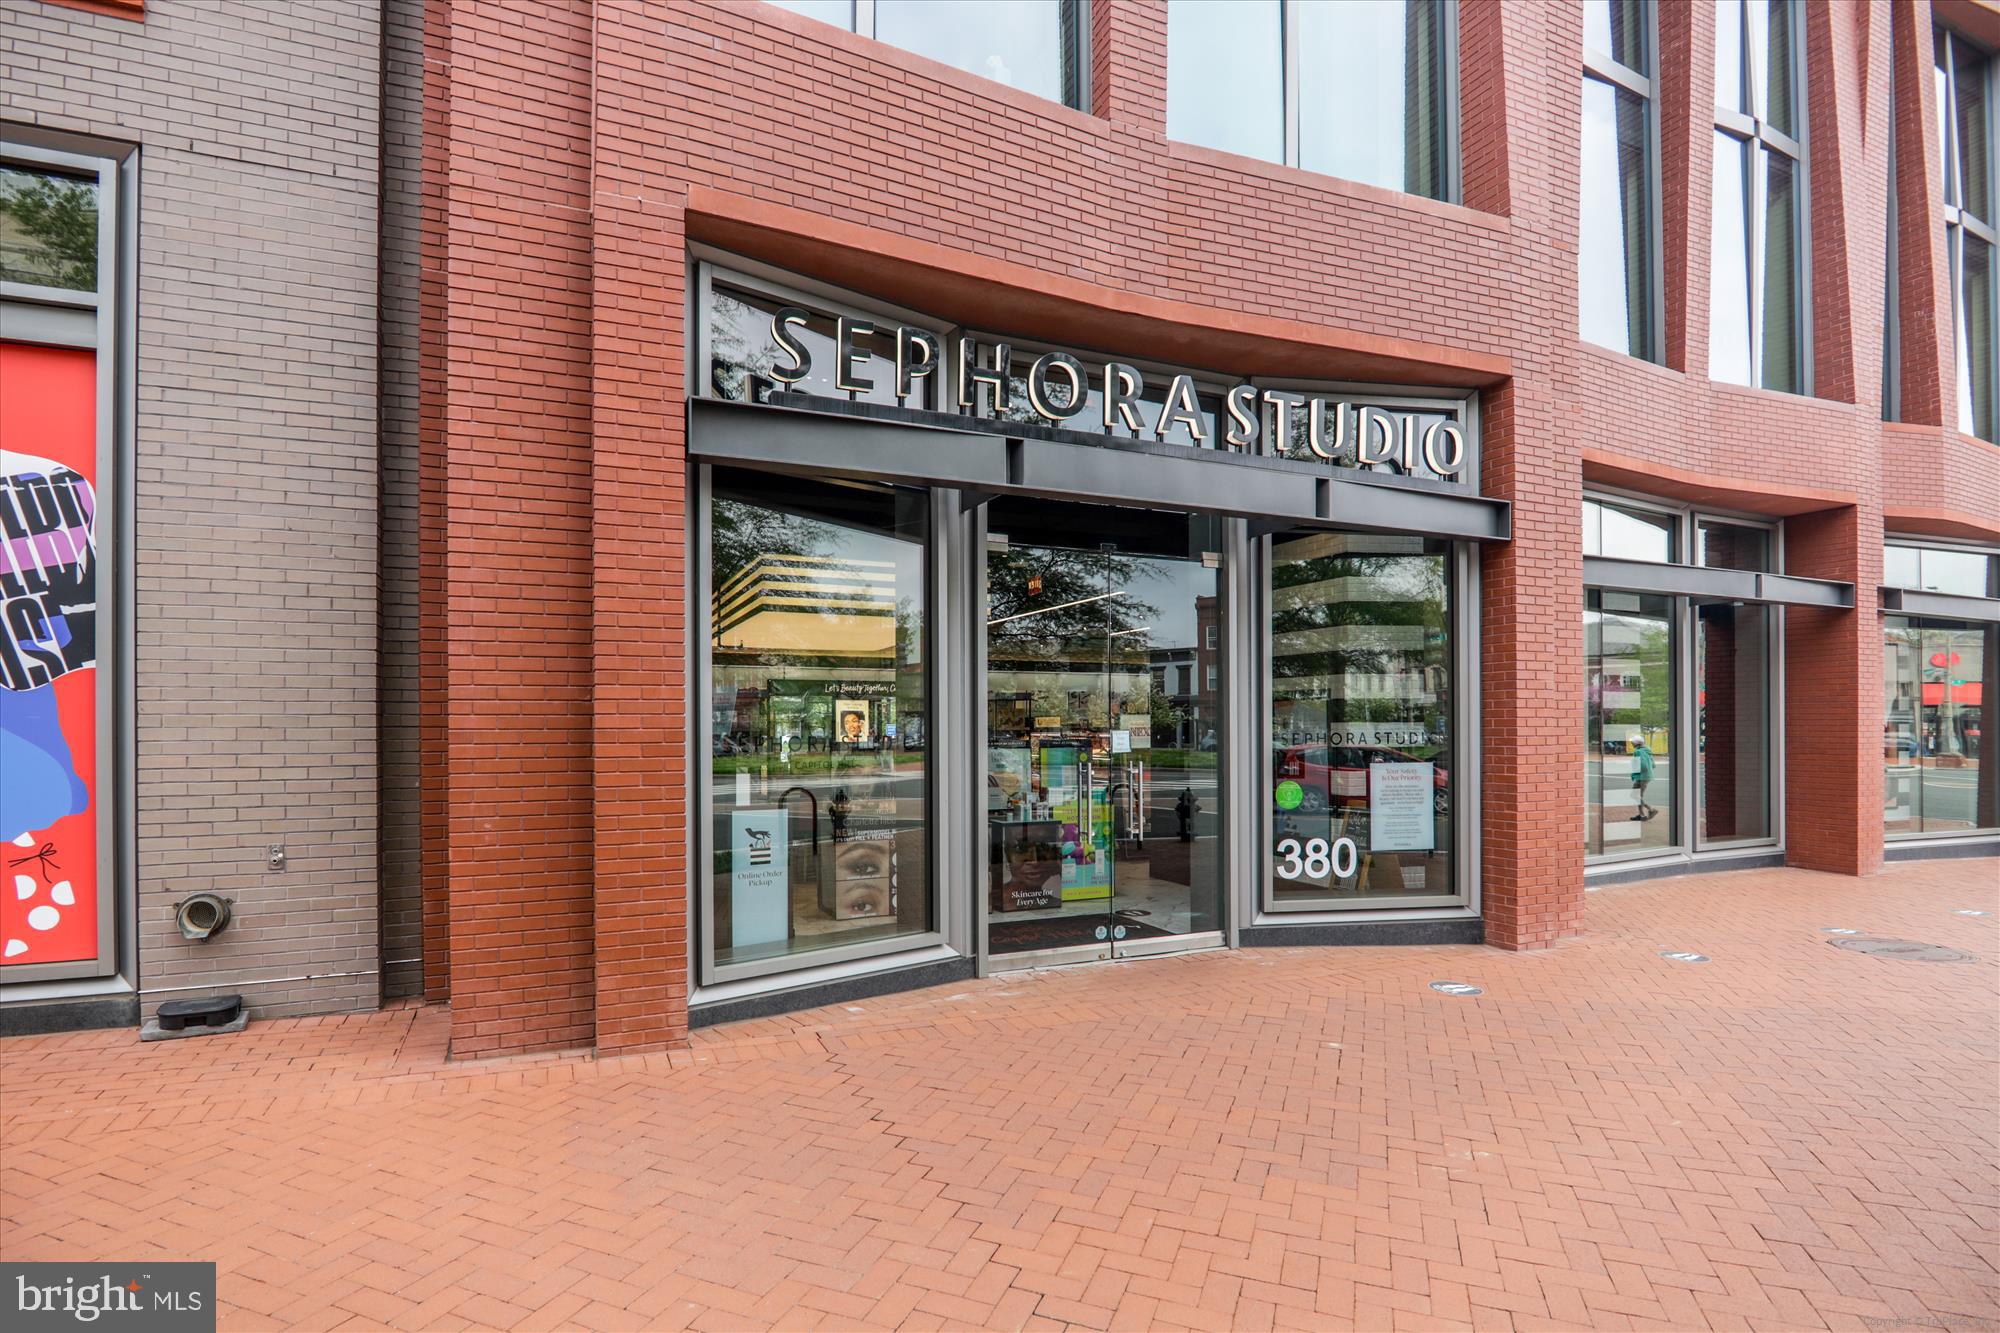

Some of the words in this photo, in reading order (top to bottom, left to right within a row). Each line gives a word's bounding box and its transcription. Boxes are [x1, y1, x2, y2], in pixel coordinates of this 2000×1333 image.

[768, 306, 1208, 440] SEPHORA
[1227, 384, 1469, 476] STUDIO
[1281, 731, 1368, 746] SEPHORA
[1277, 837, 1357, 880] 380
[737, 872, 761, 880] Online
[762, 870, 783, 878] Order
[748, 879, 773, 887] Pickup
[1011, 890, 1042, 898] Skincare
[1016, 897, 1035, 906] Every
[1036, 897, 1049, 905] Age
